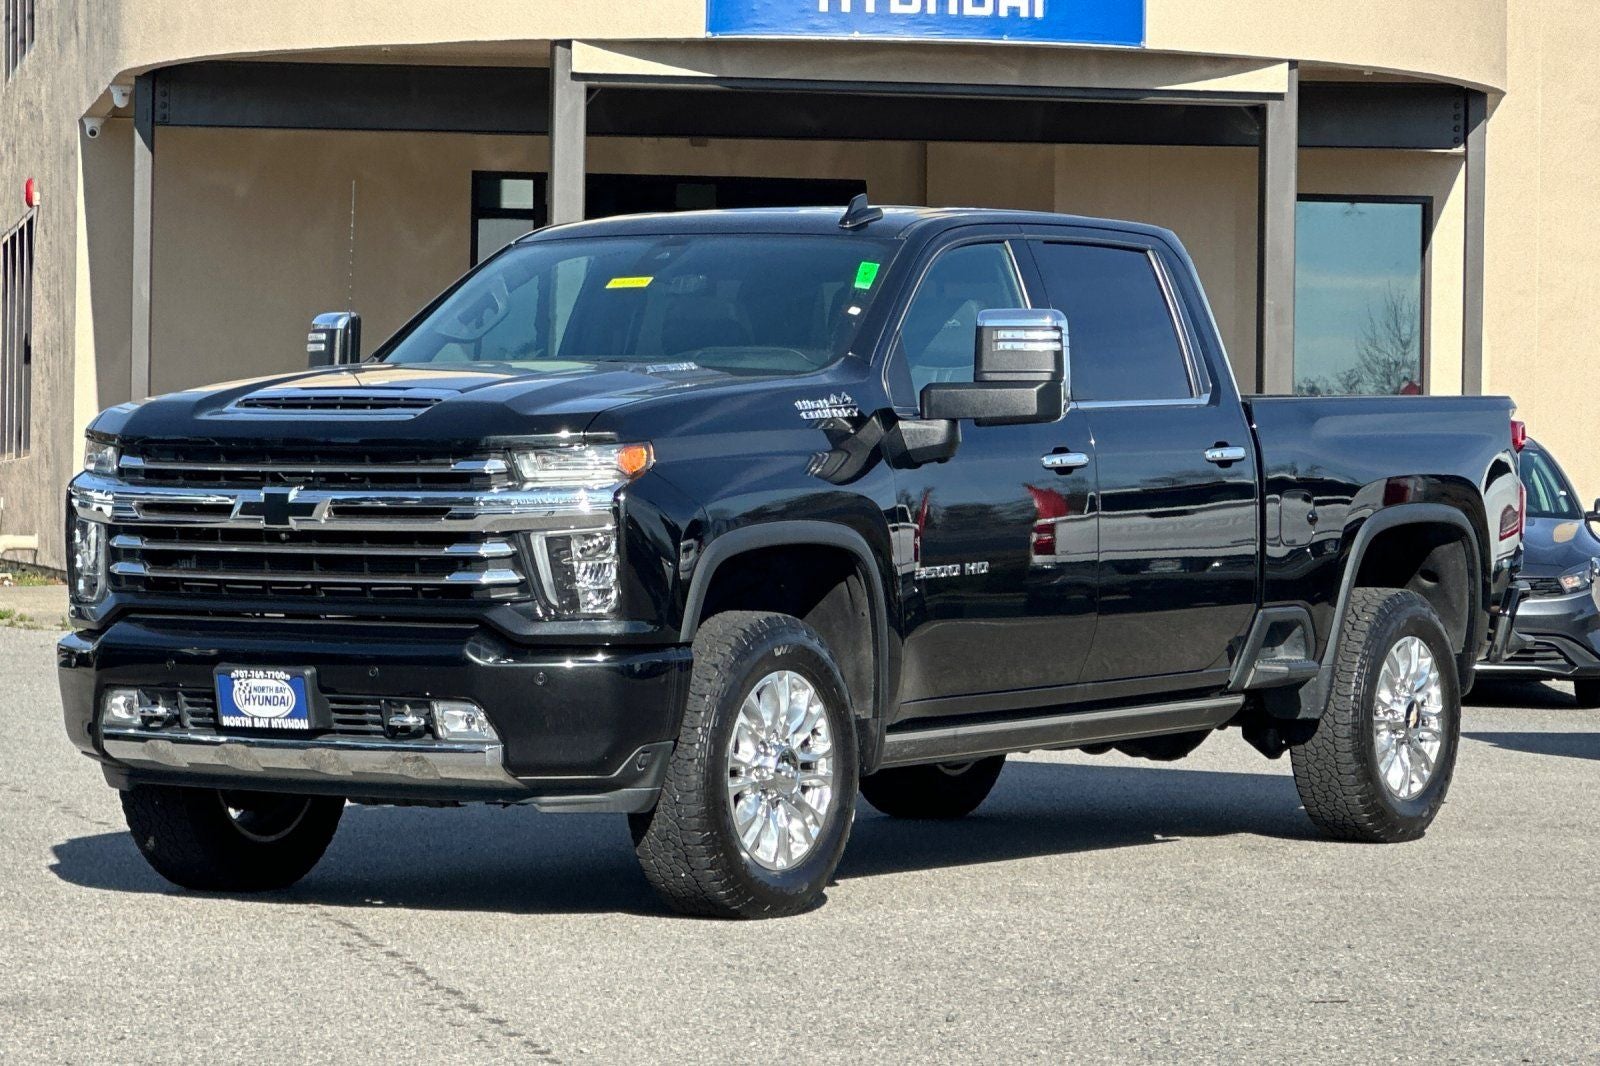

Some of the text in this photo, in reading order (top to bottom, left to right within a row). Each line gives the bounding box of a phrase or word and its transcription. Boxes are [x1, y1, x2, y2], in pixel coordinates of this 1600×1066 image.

[964, 561, 990, 576] HD
[253, 685, 287, 695] NORTH BAY
[244, 694, 290, 707] HYUNDAI
[222, 715, 309, 730] NORTH BAY HYUNDAI
